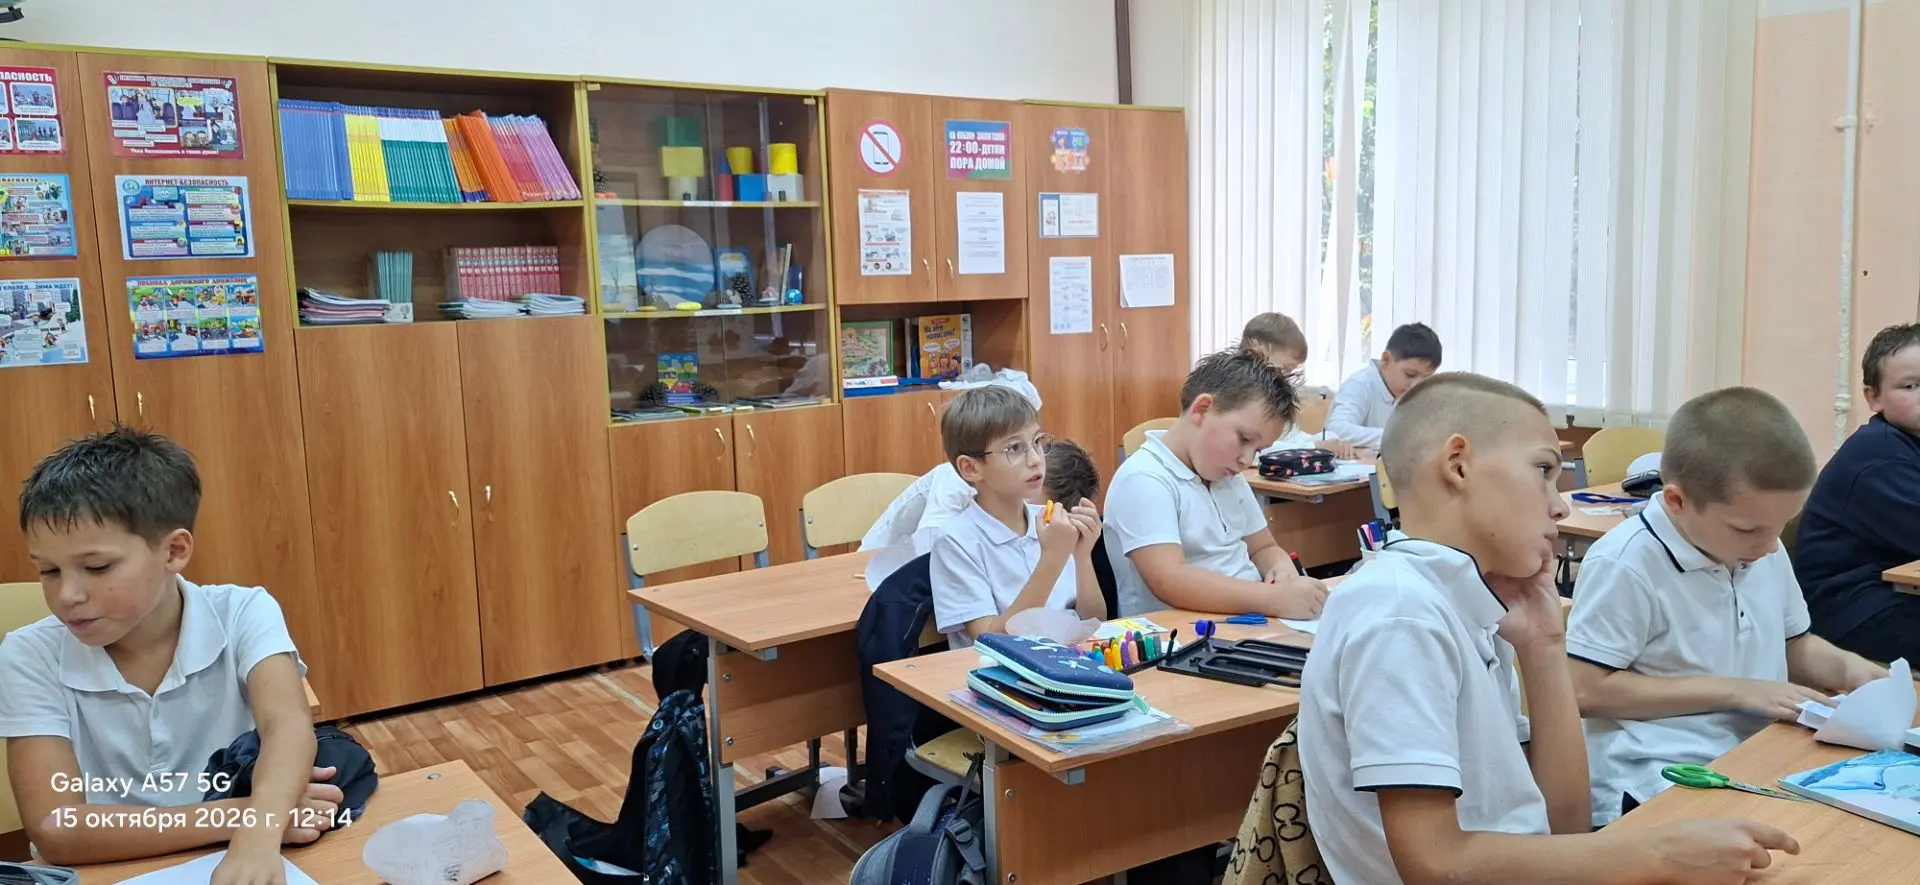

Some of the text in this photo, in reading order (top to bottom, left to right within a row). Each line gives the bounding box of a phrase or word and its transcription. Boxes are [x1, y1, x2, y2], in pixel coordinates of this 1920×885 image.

[949, 141, 978, 154] 22:00
[949, 156, 1006, 171] ПОРА ДОМОЙ
